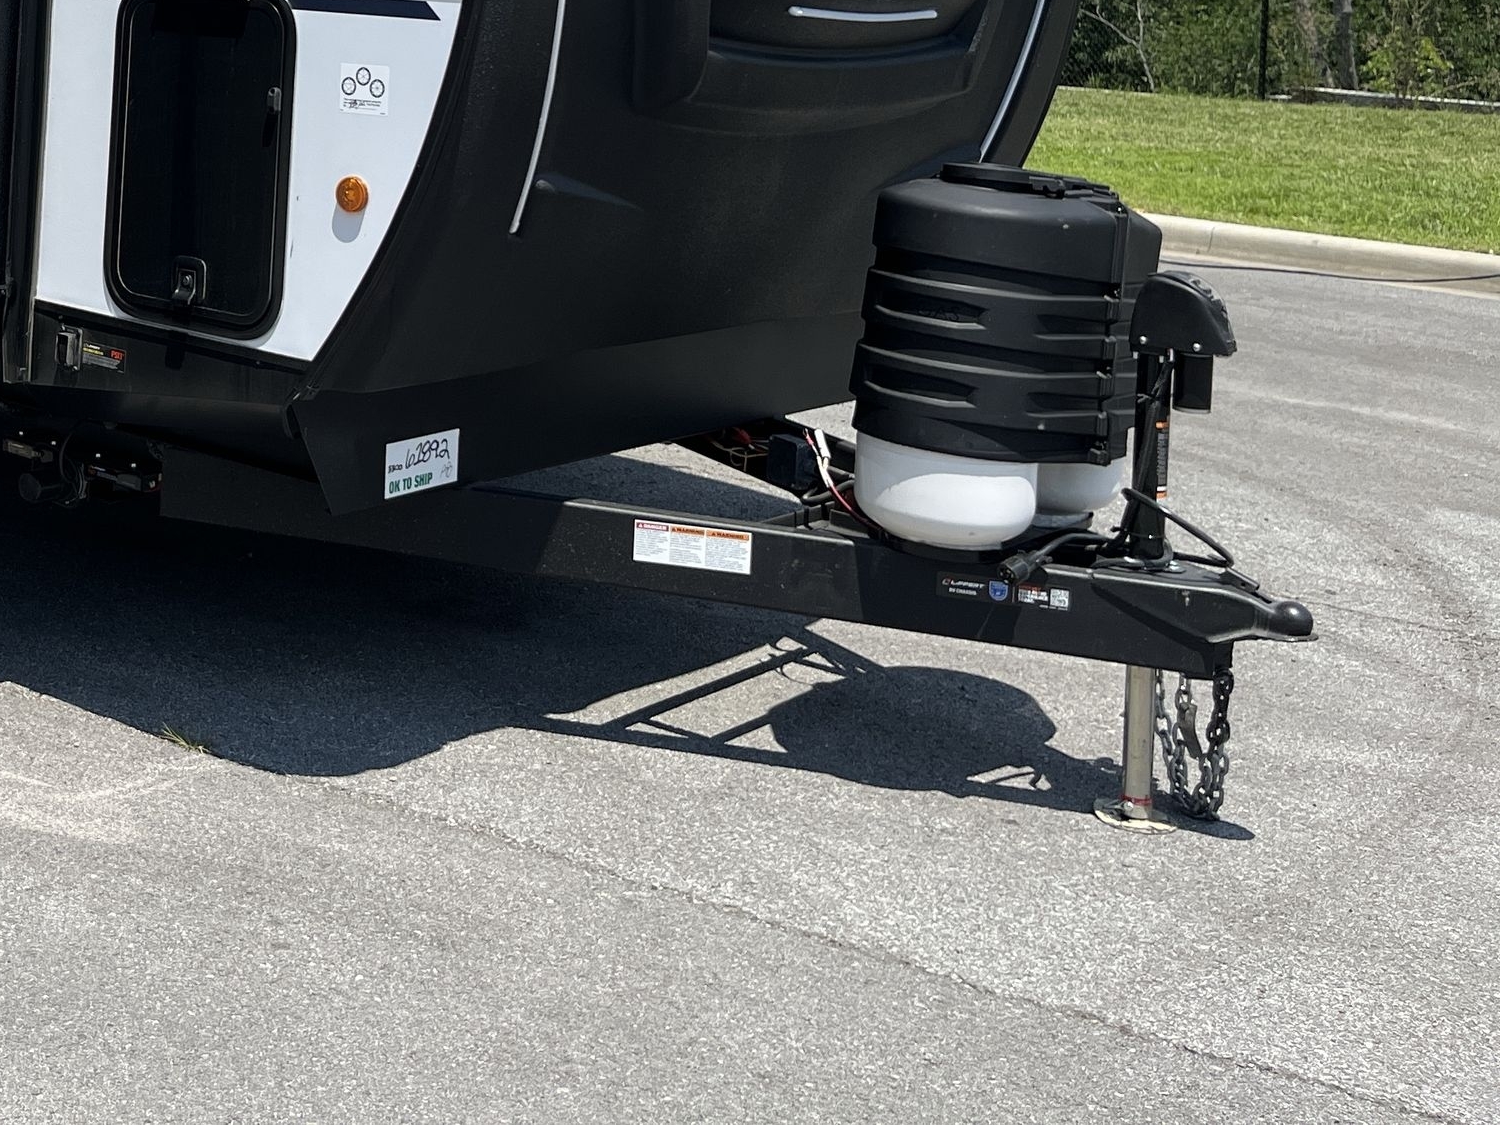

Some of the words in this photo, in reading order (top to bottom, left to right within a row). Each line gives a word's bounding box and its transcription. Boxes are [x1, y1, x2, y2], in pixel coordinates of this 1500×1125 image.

[389, 479, 401, 494] OK
[402, 476, 412, 491] TO
[414, 472, 433, 488] SHIP
